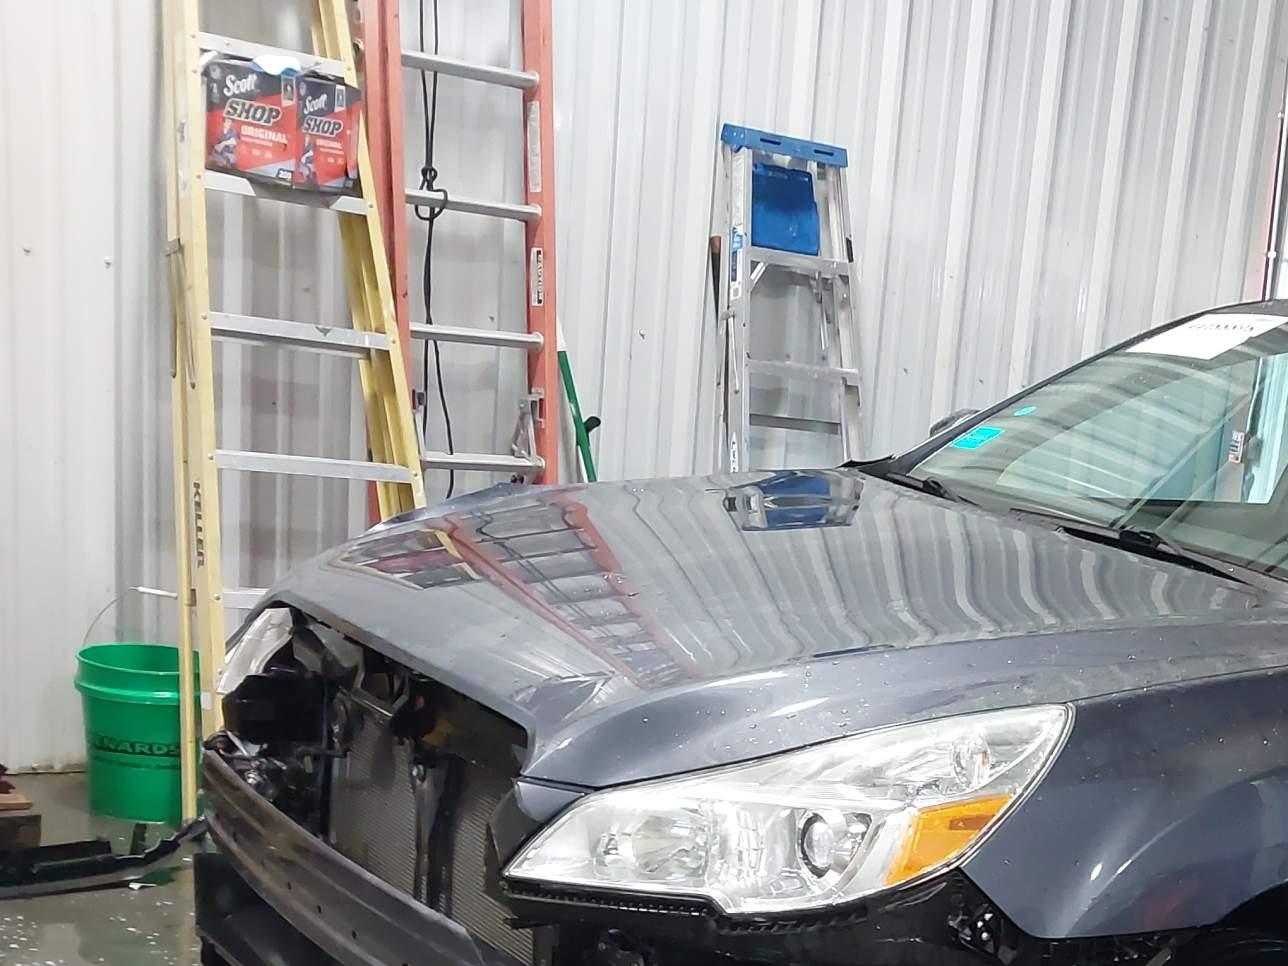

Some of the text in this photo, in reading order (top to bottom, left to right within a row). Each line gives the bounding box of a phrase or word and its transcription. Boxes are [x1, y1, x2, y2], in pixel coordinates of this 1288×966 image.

[223, 74, 257, 97] Scott
[224, 98, 282, 126] SHOP
[303, 115, 344, 137] SHOP
